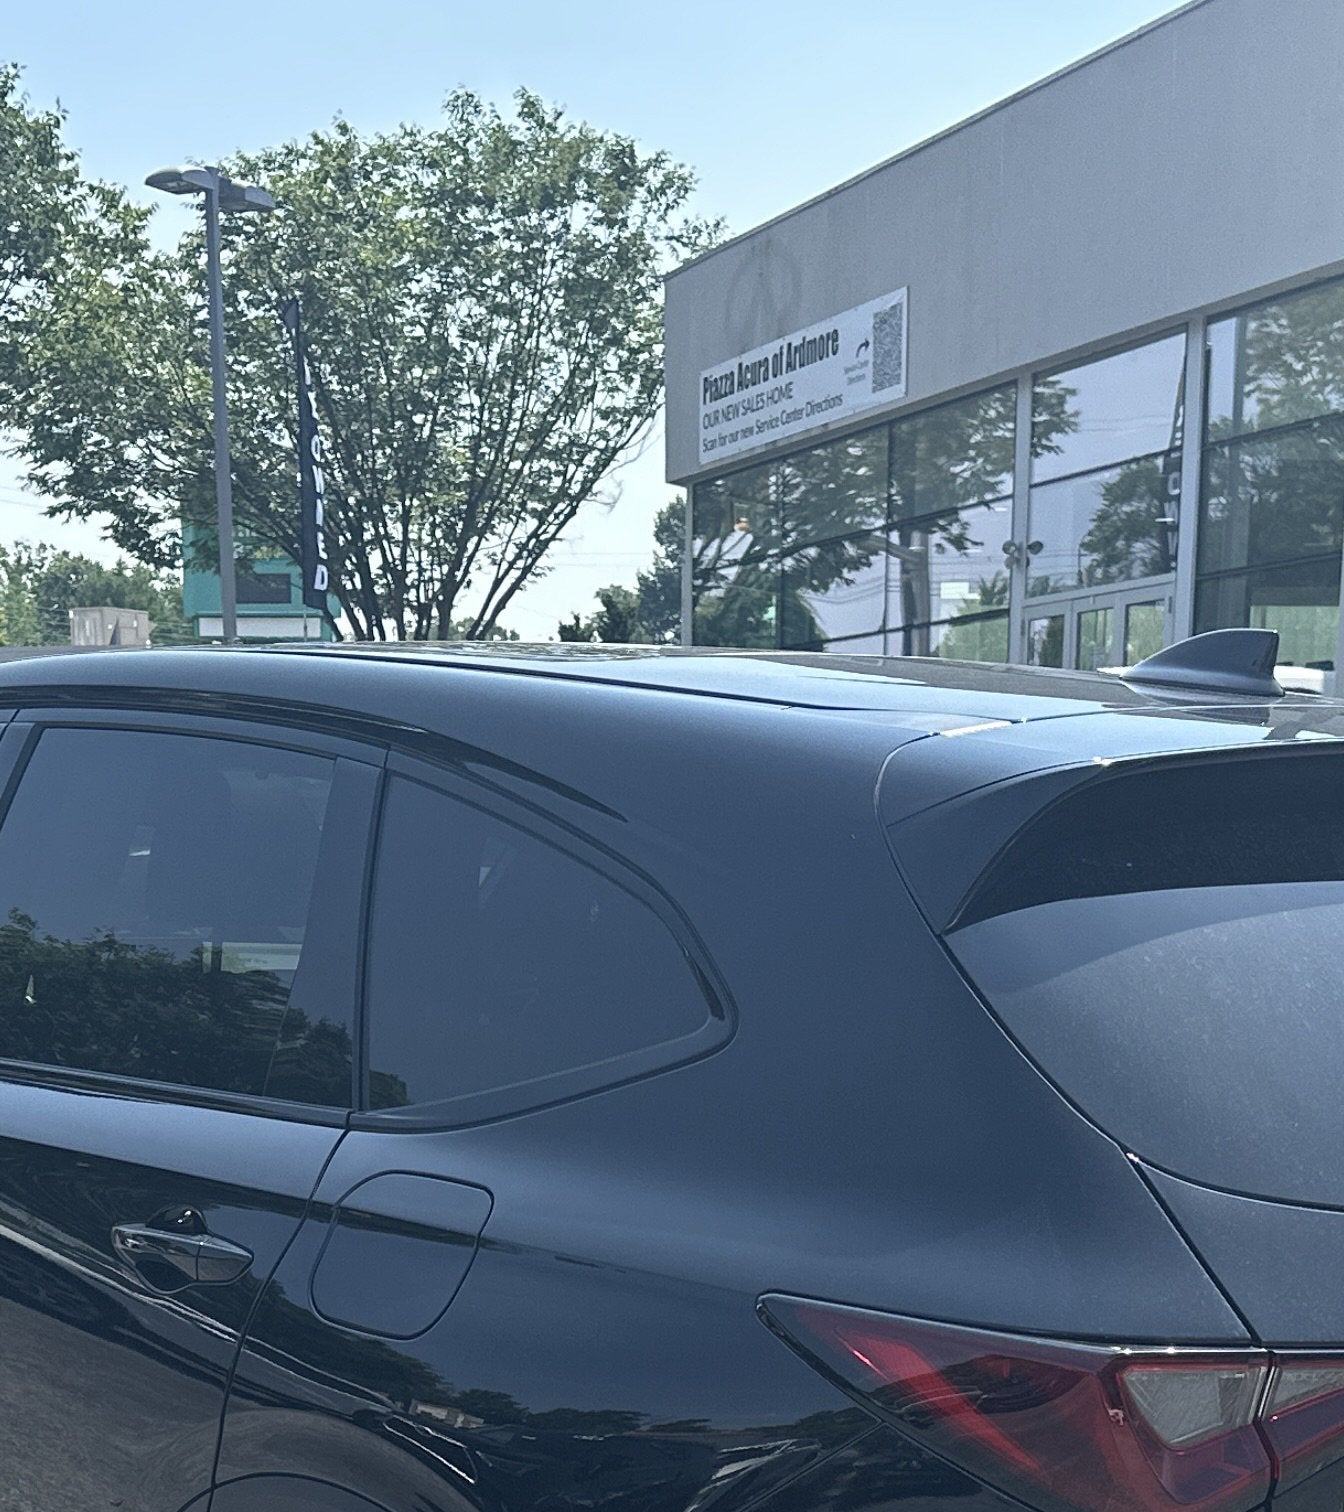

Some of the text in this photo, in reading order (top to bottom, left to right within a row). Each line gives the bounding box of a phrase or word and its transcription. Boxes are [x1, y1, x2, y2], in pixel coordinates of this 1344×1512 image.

[703, 371, 735, 405] Piazza
[737, 356, 769, 392] Acura
[772, 345, 784, 378] of
[785, 328, 839, 373] Ardmore
[703, 381, 794, 430] OUR NEW SALES HOME
[703, 394, 843, 452] Scan for our new Service Center Directions
